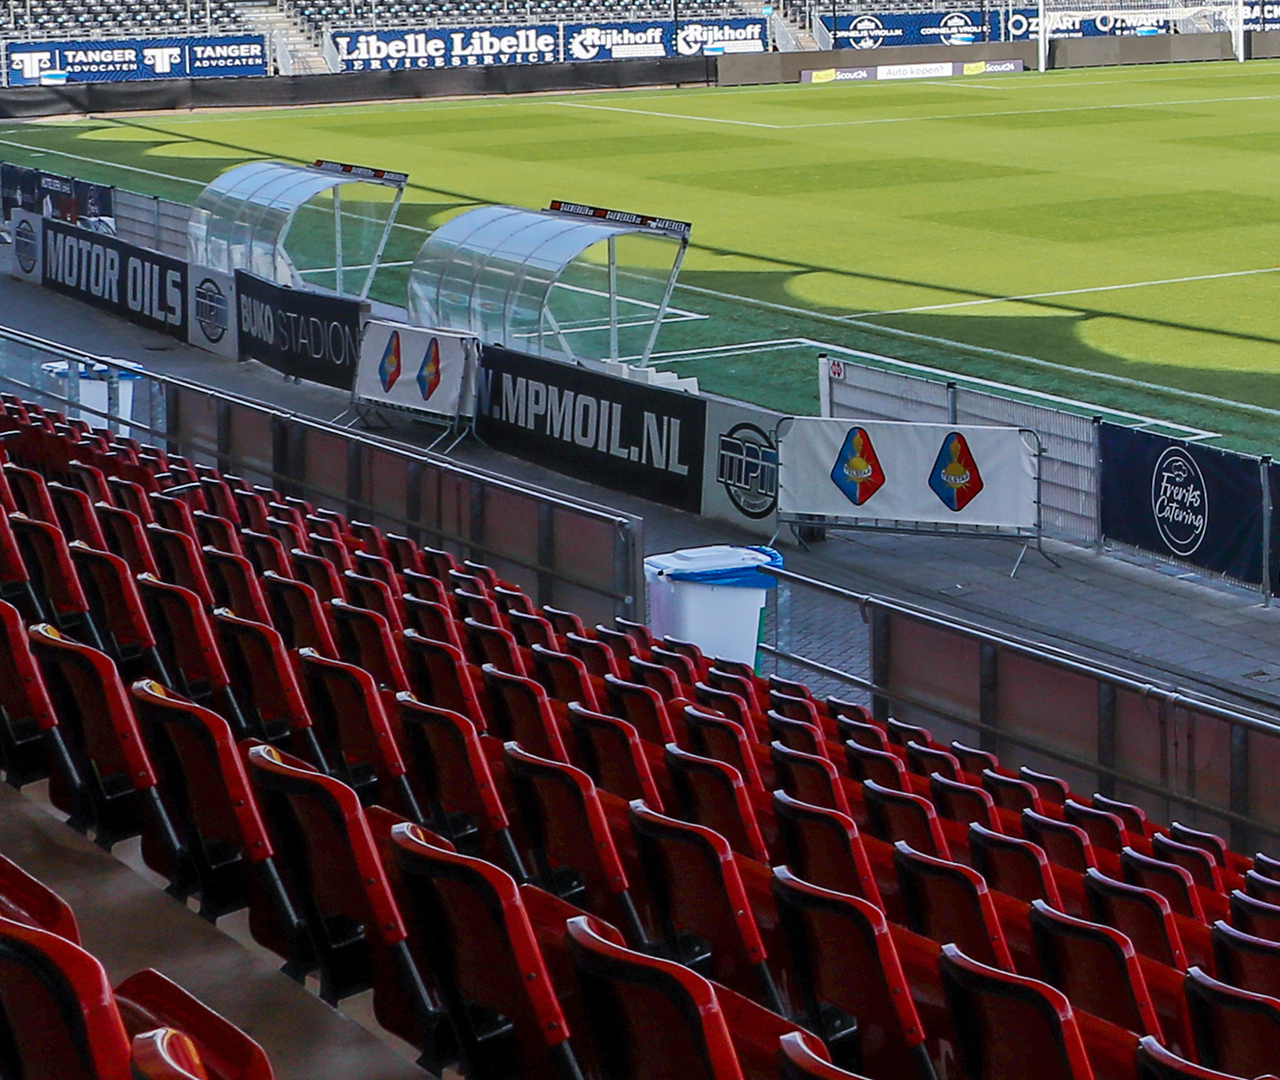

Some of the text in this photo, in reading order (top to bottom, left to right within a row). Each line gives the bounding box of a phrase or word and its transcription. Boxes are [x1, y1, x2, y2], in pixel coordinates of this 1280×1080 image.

[919, 25, 991, 35] CORNELIS VROLI
[1028, 17, 1083, 32] ZART
[449, 29, 557, 58] Libelle
[581, 26, 664, 50] Rijkhoff
[687, 23, 763, 47] Rijkhoff
[192, 43, 264, 63] TANGER
[335, 33, 446, 60] Libelle
[63, 49, 137, 67] TANGER
[193, 57, 264, 69] ADVOCATEN
[339, 57, 444, 71] SERVICE
[451, 51, 556, 68] SERVICE
[64, 62, 139, 75] ADVOCATEN
[885, 64, 946, 79] Auto kopen?
[46, 229, 120, 304] MOTOR
[127, 256, 183, 326] OILS
[241, 293, 275, 346] BUKO
[276, 309, 362, 367] STADION
[1160, 471, 1201, 508] Freriks
[1155, 495, 1204, 534] Catering
